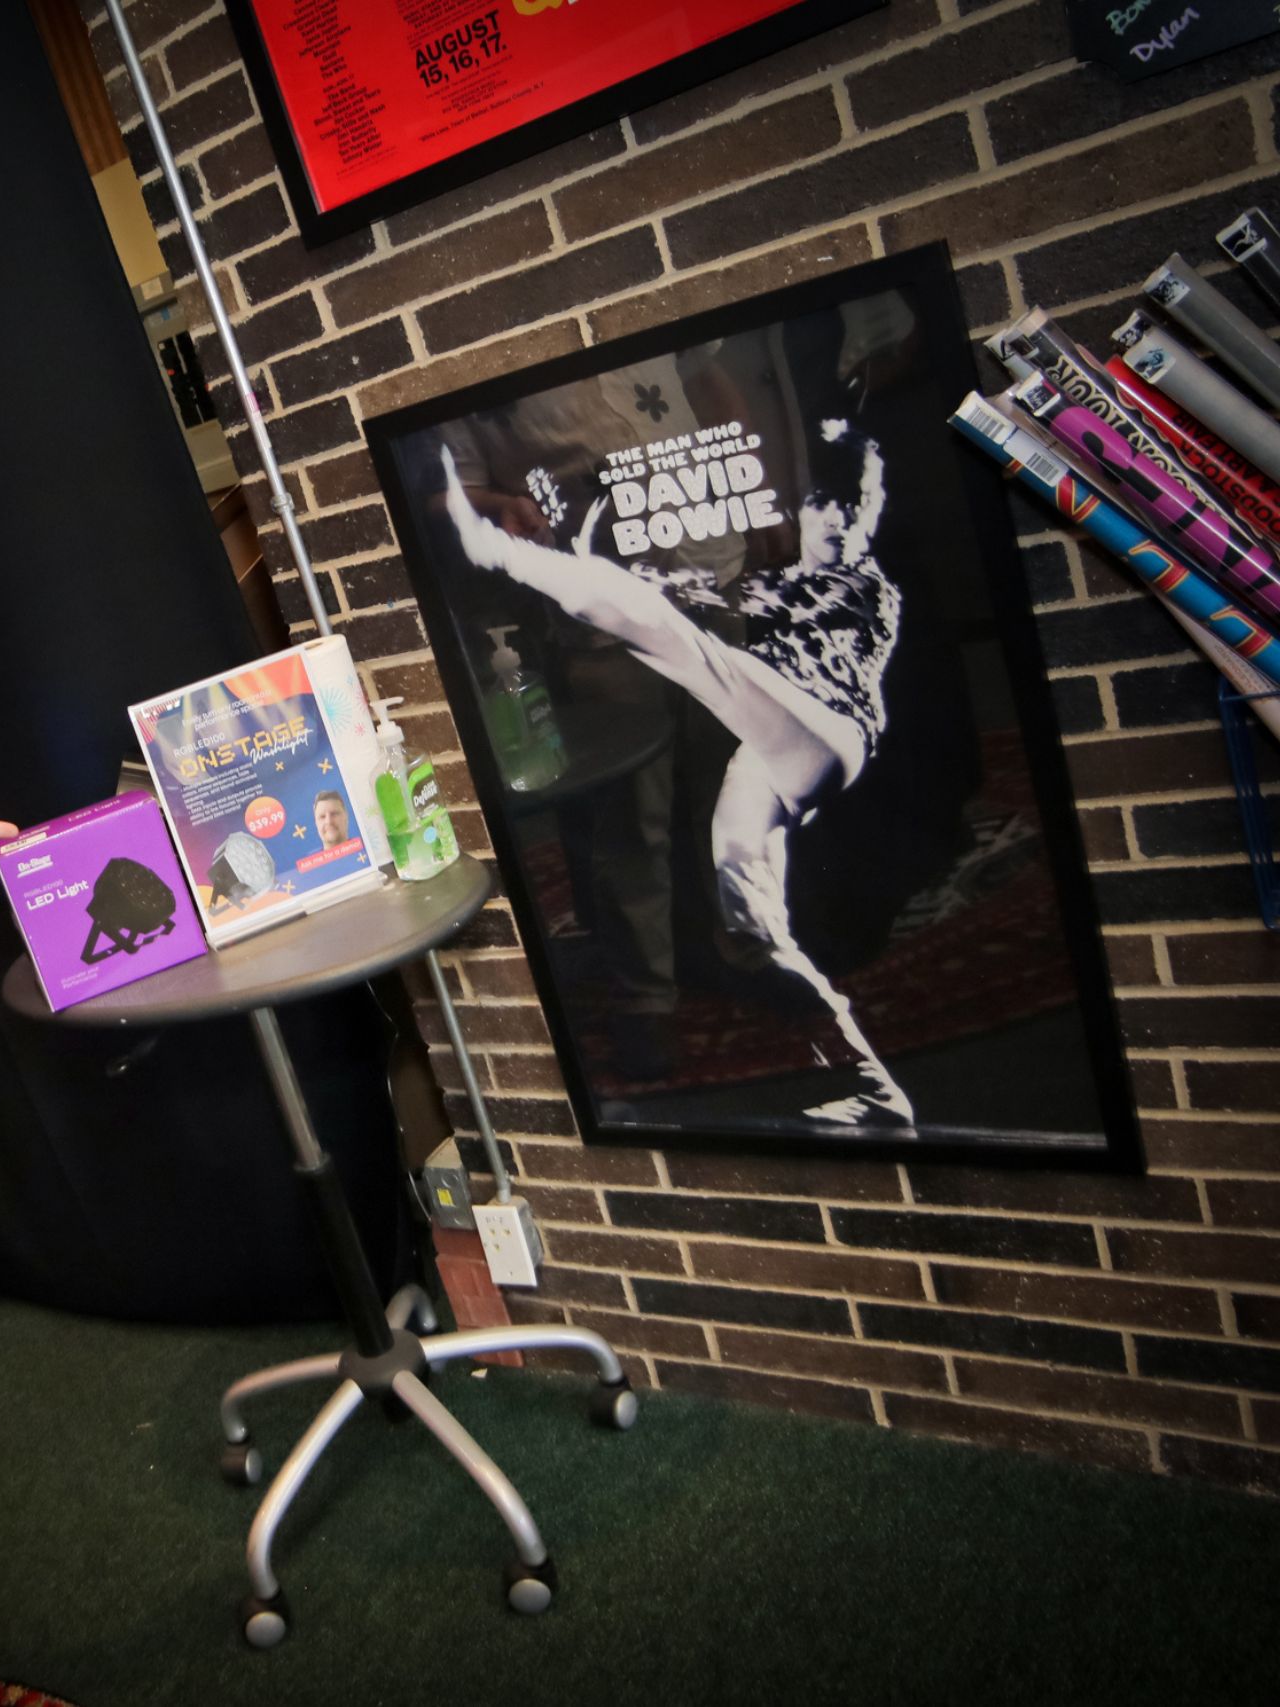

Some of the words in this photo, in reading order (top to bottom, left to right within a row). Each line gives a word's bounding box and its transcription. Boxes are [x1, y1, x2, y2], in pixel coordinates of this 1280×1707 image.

[416, 9, 499, 70] AUGUST
[420, 64, 449, 88] 15,
[449, 49, 479, 73] 16,
[480, 32, 507, 58] 17.
[1129, 7, 1200, 62] Dylan
[599, 463, 646, 485] SOLD
[649, 452, 688, 472] THE
[691, 434, 761, 462] WORLD
[606, 447, 644, 467] THE
[647, 434, 692, 458] MAN
[695, 422, 742, 444] WHO
[611, 454, 763, 518] DAVID
[612, 489, 784, 556] BOWIE
[180, 716, 306, 777] ONSTAGE
[250, 728, 314, 764] Washlight
[249, 812, 284, 832] $39.99
[27, 893, 54, 910] LED
[56, 880, 89, 899] Light
